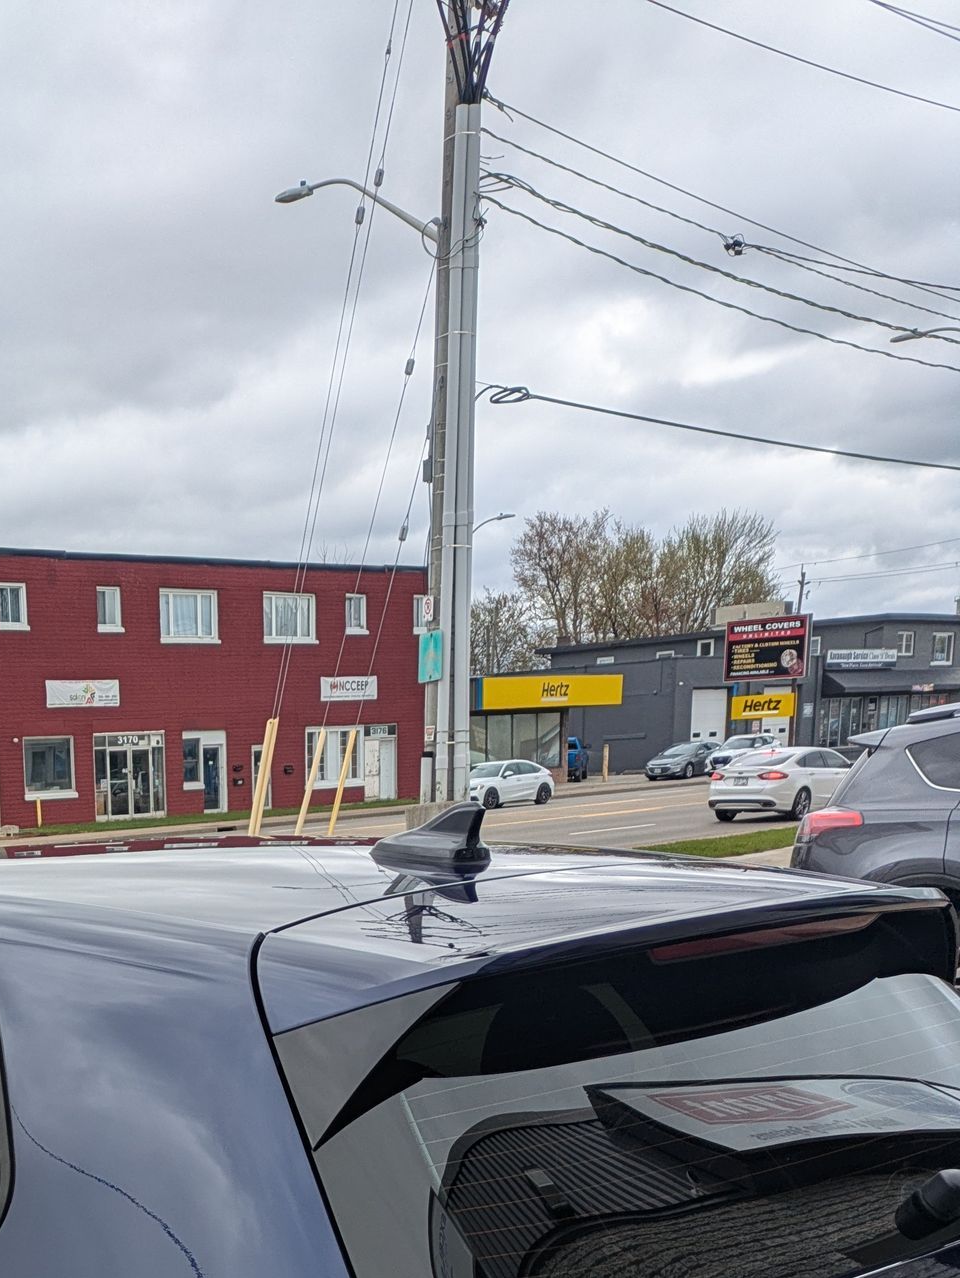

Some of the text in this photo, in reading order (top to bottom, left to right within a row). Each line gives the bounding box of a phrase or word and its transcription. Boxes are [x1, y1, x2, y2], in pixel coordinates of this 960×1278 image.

[734, 620, 801, 633] WHEEL COVERS
[742, 630, 792, 639] UNLIMITED
[541, 682, 570, 697] Hertz
[742, 698, 782, 712] Hertz
[371, 727, 387, 735] 3176
[117, 735, 138, 744] 3170
